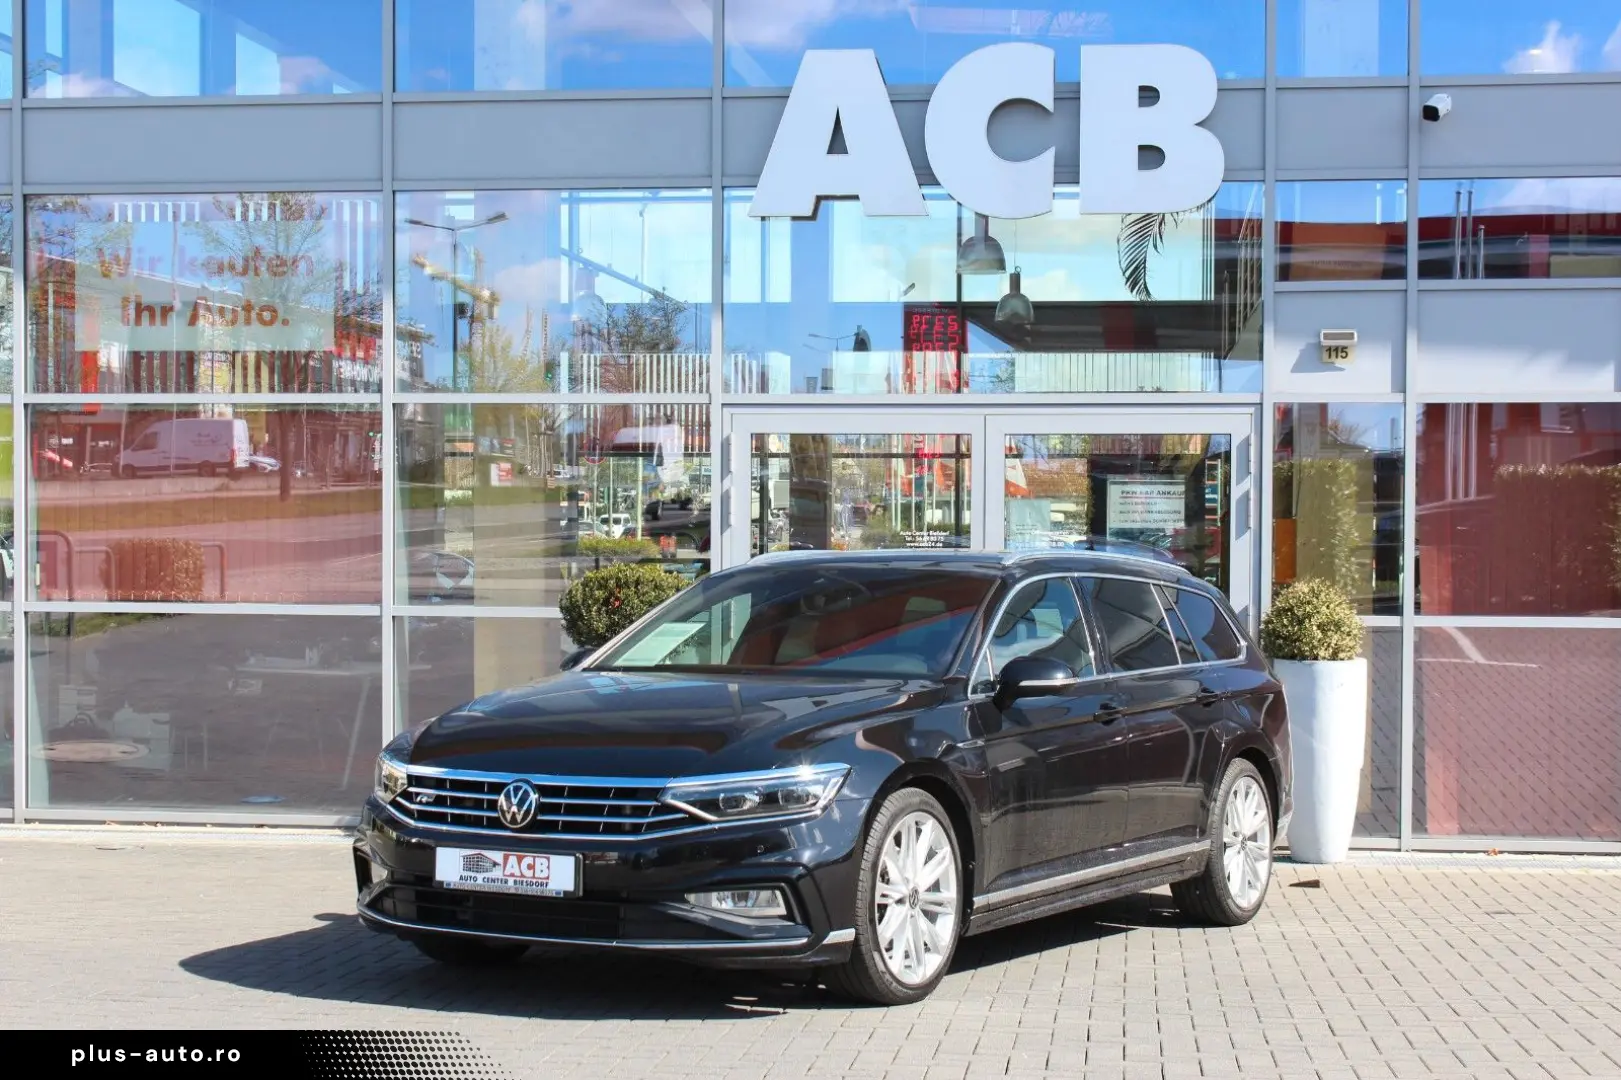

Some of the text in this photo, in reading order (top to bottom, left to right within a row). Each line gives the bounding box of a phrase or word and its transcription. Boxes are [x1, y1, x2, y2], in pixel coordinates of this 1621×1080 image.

[748, 42, 1225, 220] ACB
[97, 245, 314, 278] Wir kaufen
[122, 295, 291, 328] Ihr Auto.
[1325, 346, 1349, 359] 115
[498, 782, 536, 828] VW
[459, 874, 550, 889] AUTO CENTER BIESDORF
[504, 855, 549, 879] ACB
